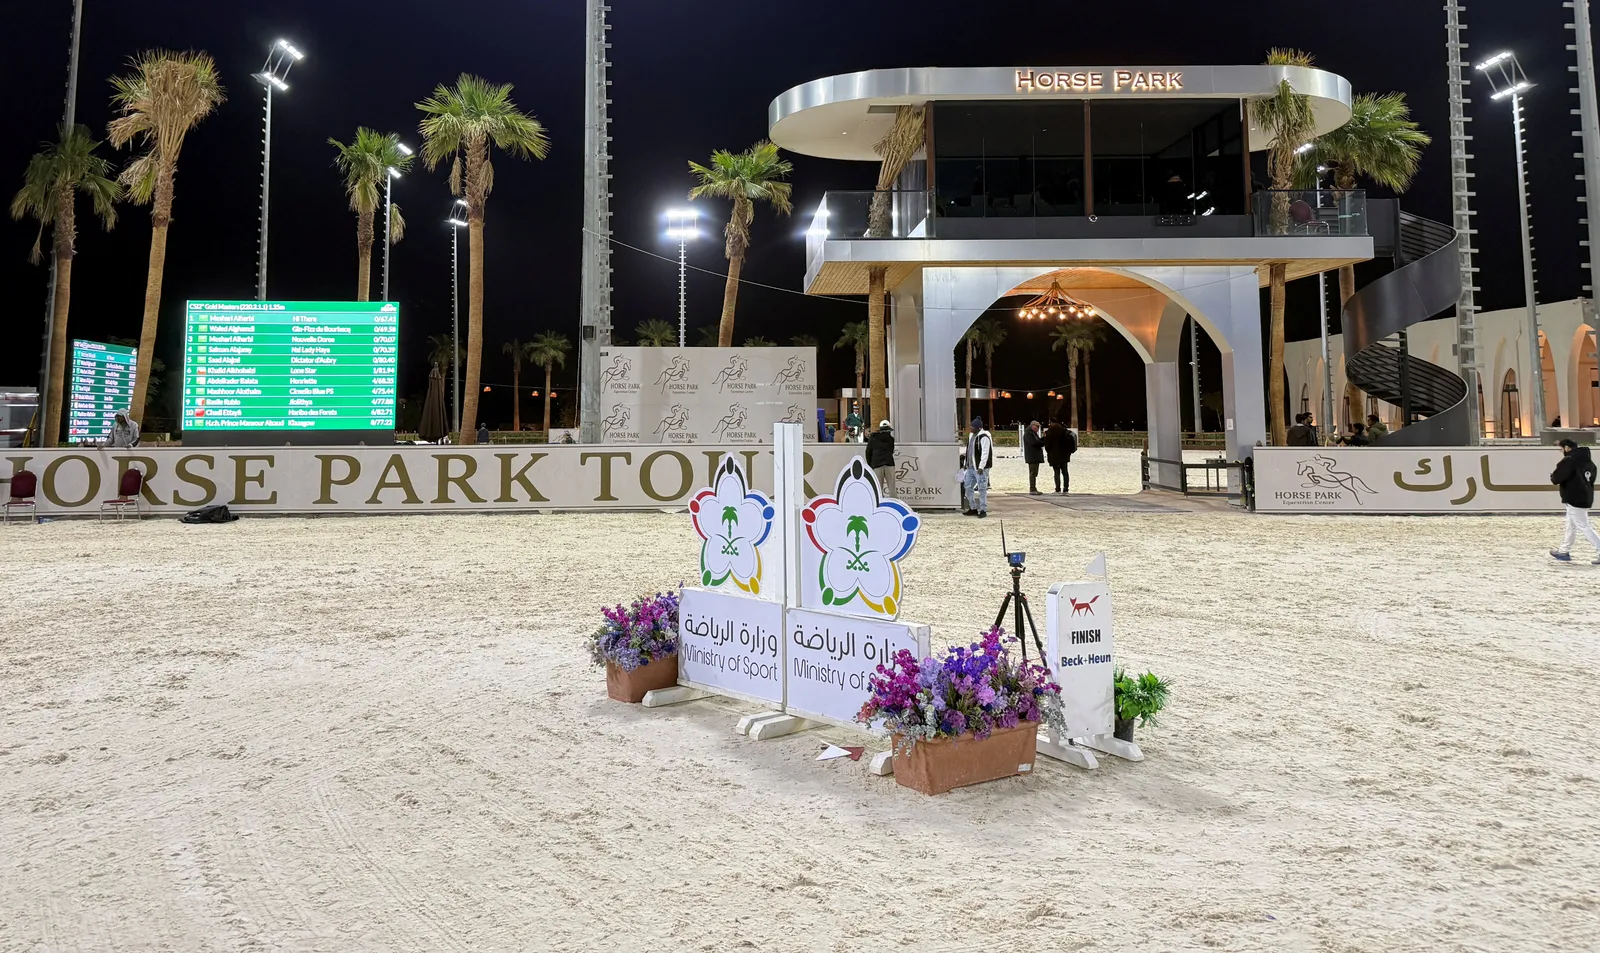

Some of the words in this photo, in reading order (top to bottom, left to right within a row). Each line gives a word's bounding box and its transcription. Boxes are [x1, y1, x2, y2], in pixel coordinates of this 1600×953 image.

[1016, 69, 1104, 93] HORSE
[1113, 69, 1184, 93] PARK
[312, 453, 550, 505] PARK
[914, 487, 942, 495] PARK
[1274, 491, 1312, 500] HORSE
[1314, 491, 1342, 500] PARK
[684, 613, 734, 646] الرياضة
[739, 622, 778, 658] وزارة
[793, 624, 856, 661] الرياضة
[1071, 628, 1101, 645] FINISH
[684, 643, 725, 672] Ministry
[727, 655, 742, 671] of
[743, 658, 778, 682] Sport
[793, 657, 845, 691] Ministry
[849, 670, 865, 691] of
